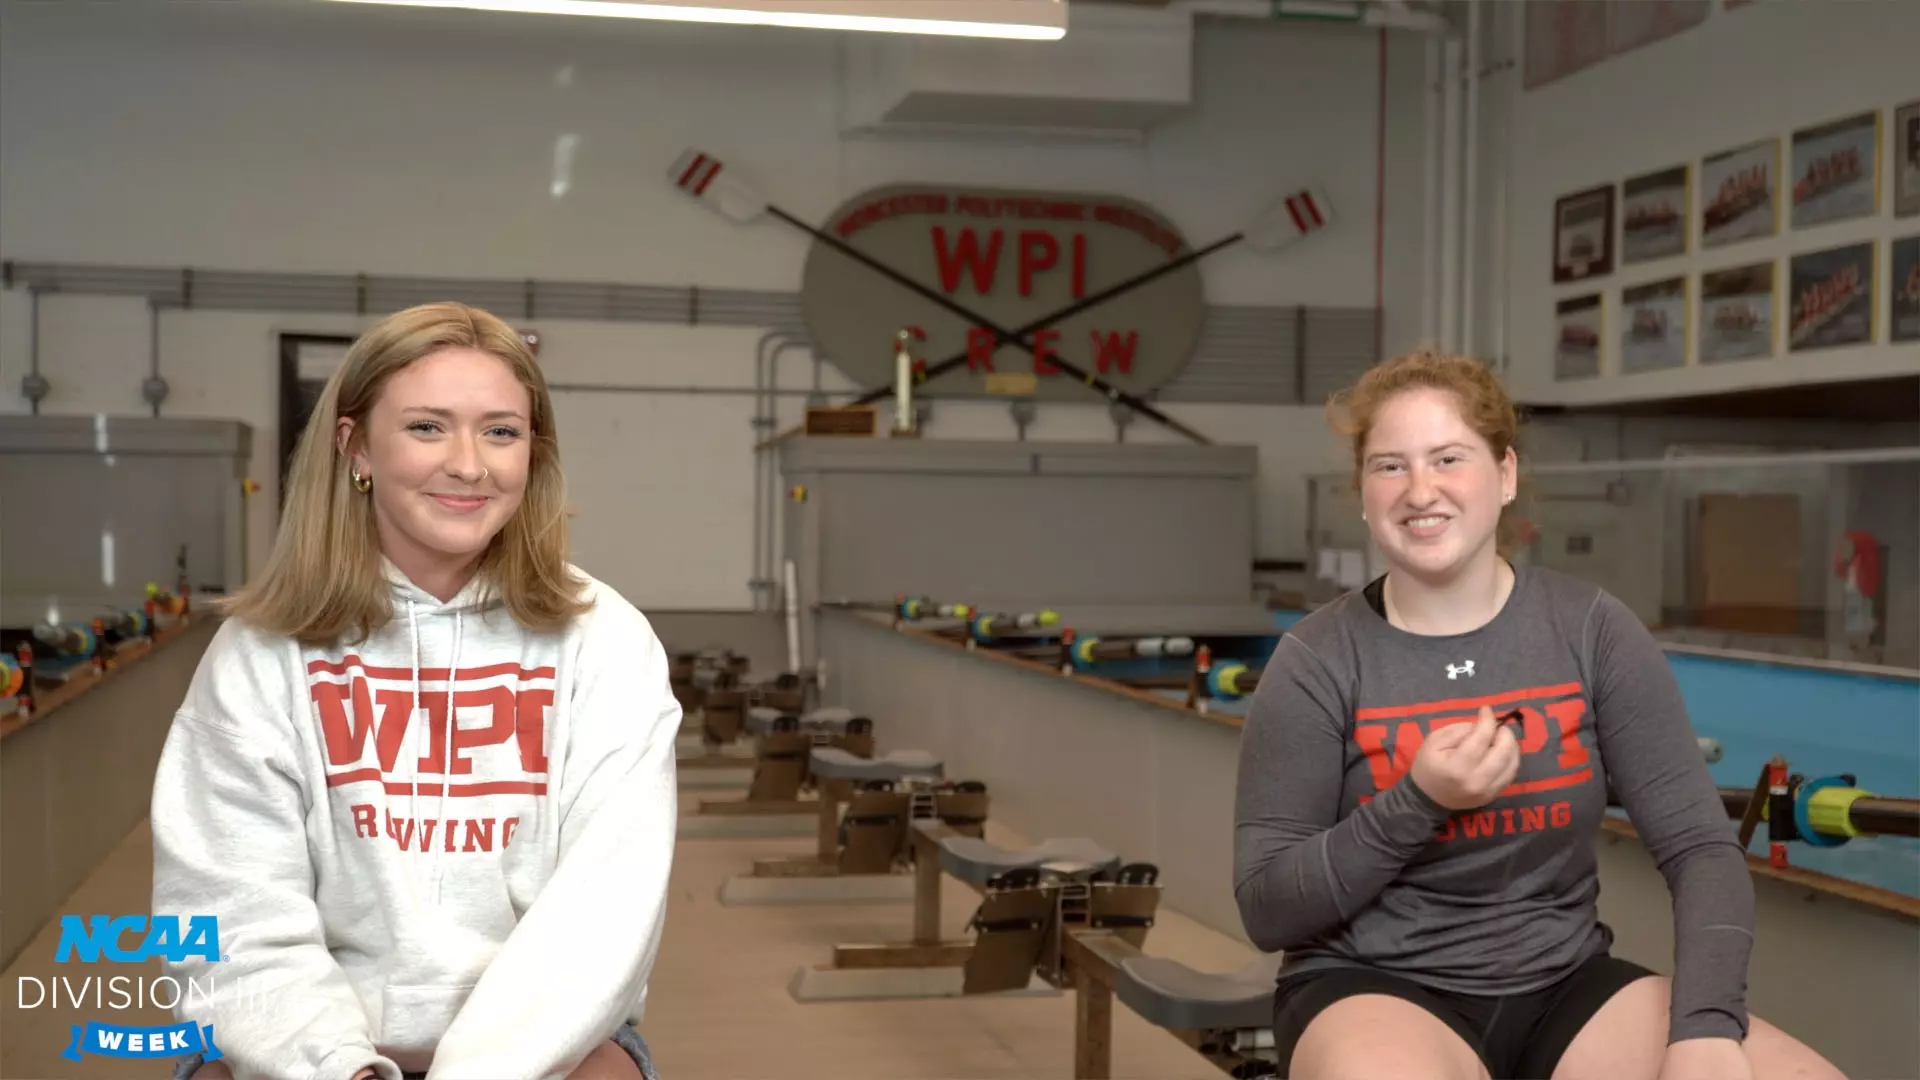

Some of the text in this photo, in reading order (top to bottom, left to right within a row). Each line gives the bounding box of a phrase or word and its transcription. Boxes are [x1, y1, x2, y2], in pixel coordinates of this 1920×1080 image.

[931, 225, 1087, 299] WPI
[310, 676, 555, 775] WPI
[1435, 801, 1572, 841] OWING
